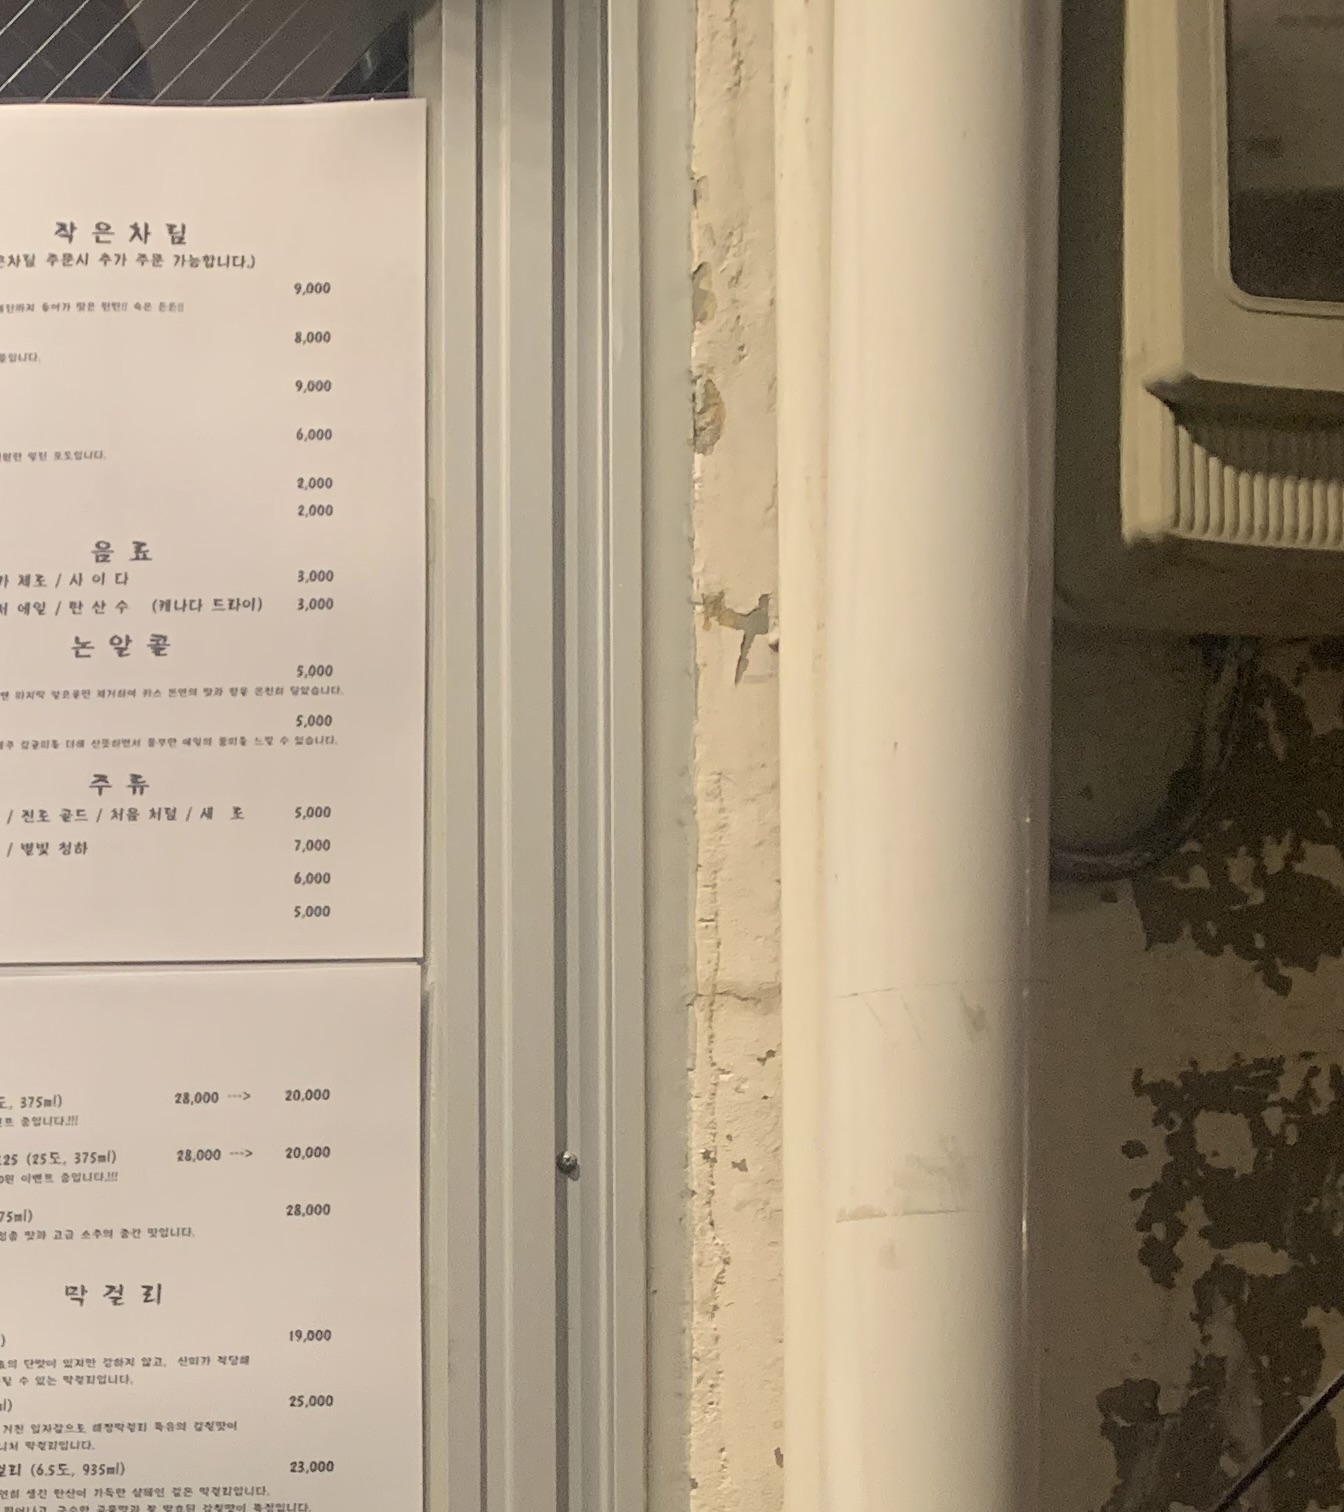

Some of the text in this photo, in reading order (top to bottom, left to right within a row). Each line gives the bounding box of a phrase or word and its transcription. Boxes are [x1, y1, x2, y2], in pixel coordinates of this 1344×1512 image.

[46, 252, 90, 268] 주문시
[135, 252, 164, 268] 주문
[293, 281, 332, 296] 9,000
[293, 330, 332, 346] 8,000
[294, 379, 333, 394] 9,000
[295, 427, 333, 442] 6,000
[296, 476, 334, 491] 2,000
[297, 503, 334, 518] 2,000
[297, 569, 335, 584] 3,000
[212, 596, 263, 612] 드라이)
[297, 597, 335, 612] 3,000
[296, 663, 334, 679] 5,000
[295, 713, 334, 729] 5,000
[294, 805, 332, 821] 5,000
[58, 840, 89, 856] 청하
[294, 838, 332, 854] 7,000
[293, 871, 332, 886] 6,000
[293, 904, 332, 919] 5,000
[20, 1093, 63, 1110] 375ml)
[174, 1090, 220, 1106] 28,000
[284, 1088, 331, 1103] 20,000
[176, 1145, 332, 1163] 28,000 20,000
[285, 1202, 332, 1218] 28,000
[289, 1328, 333, 1344] 19,000
[288, 1394, 335, 1409] 25,000
[81, 1461, 126, 1477] 935ml)
[289, 1459, 335, 1475] 23,000
